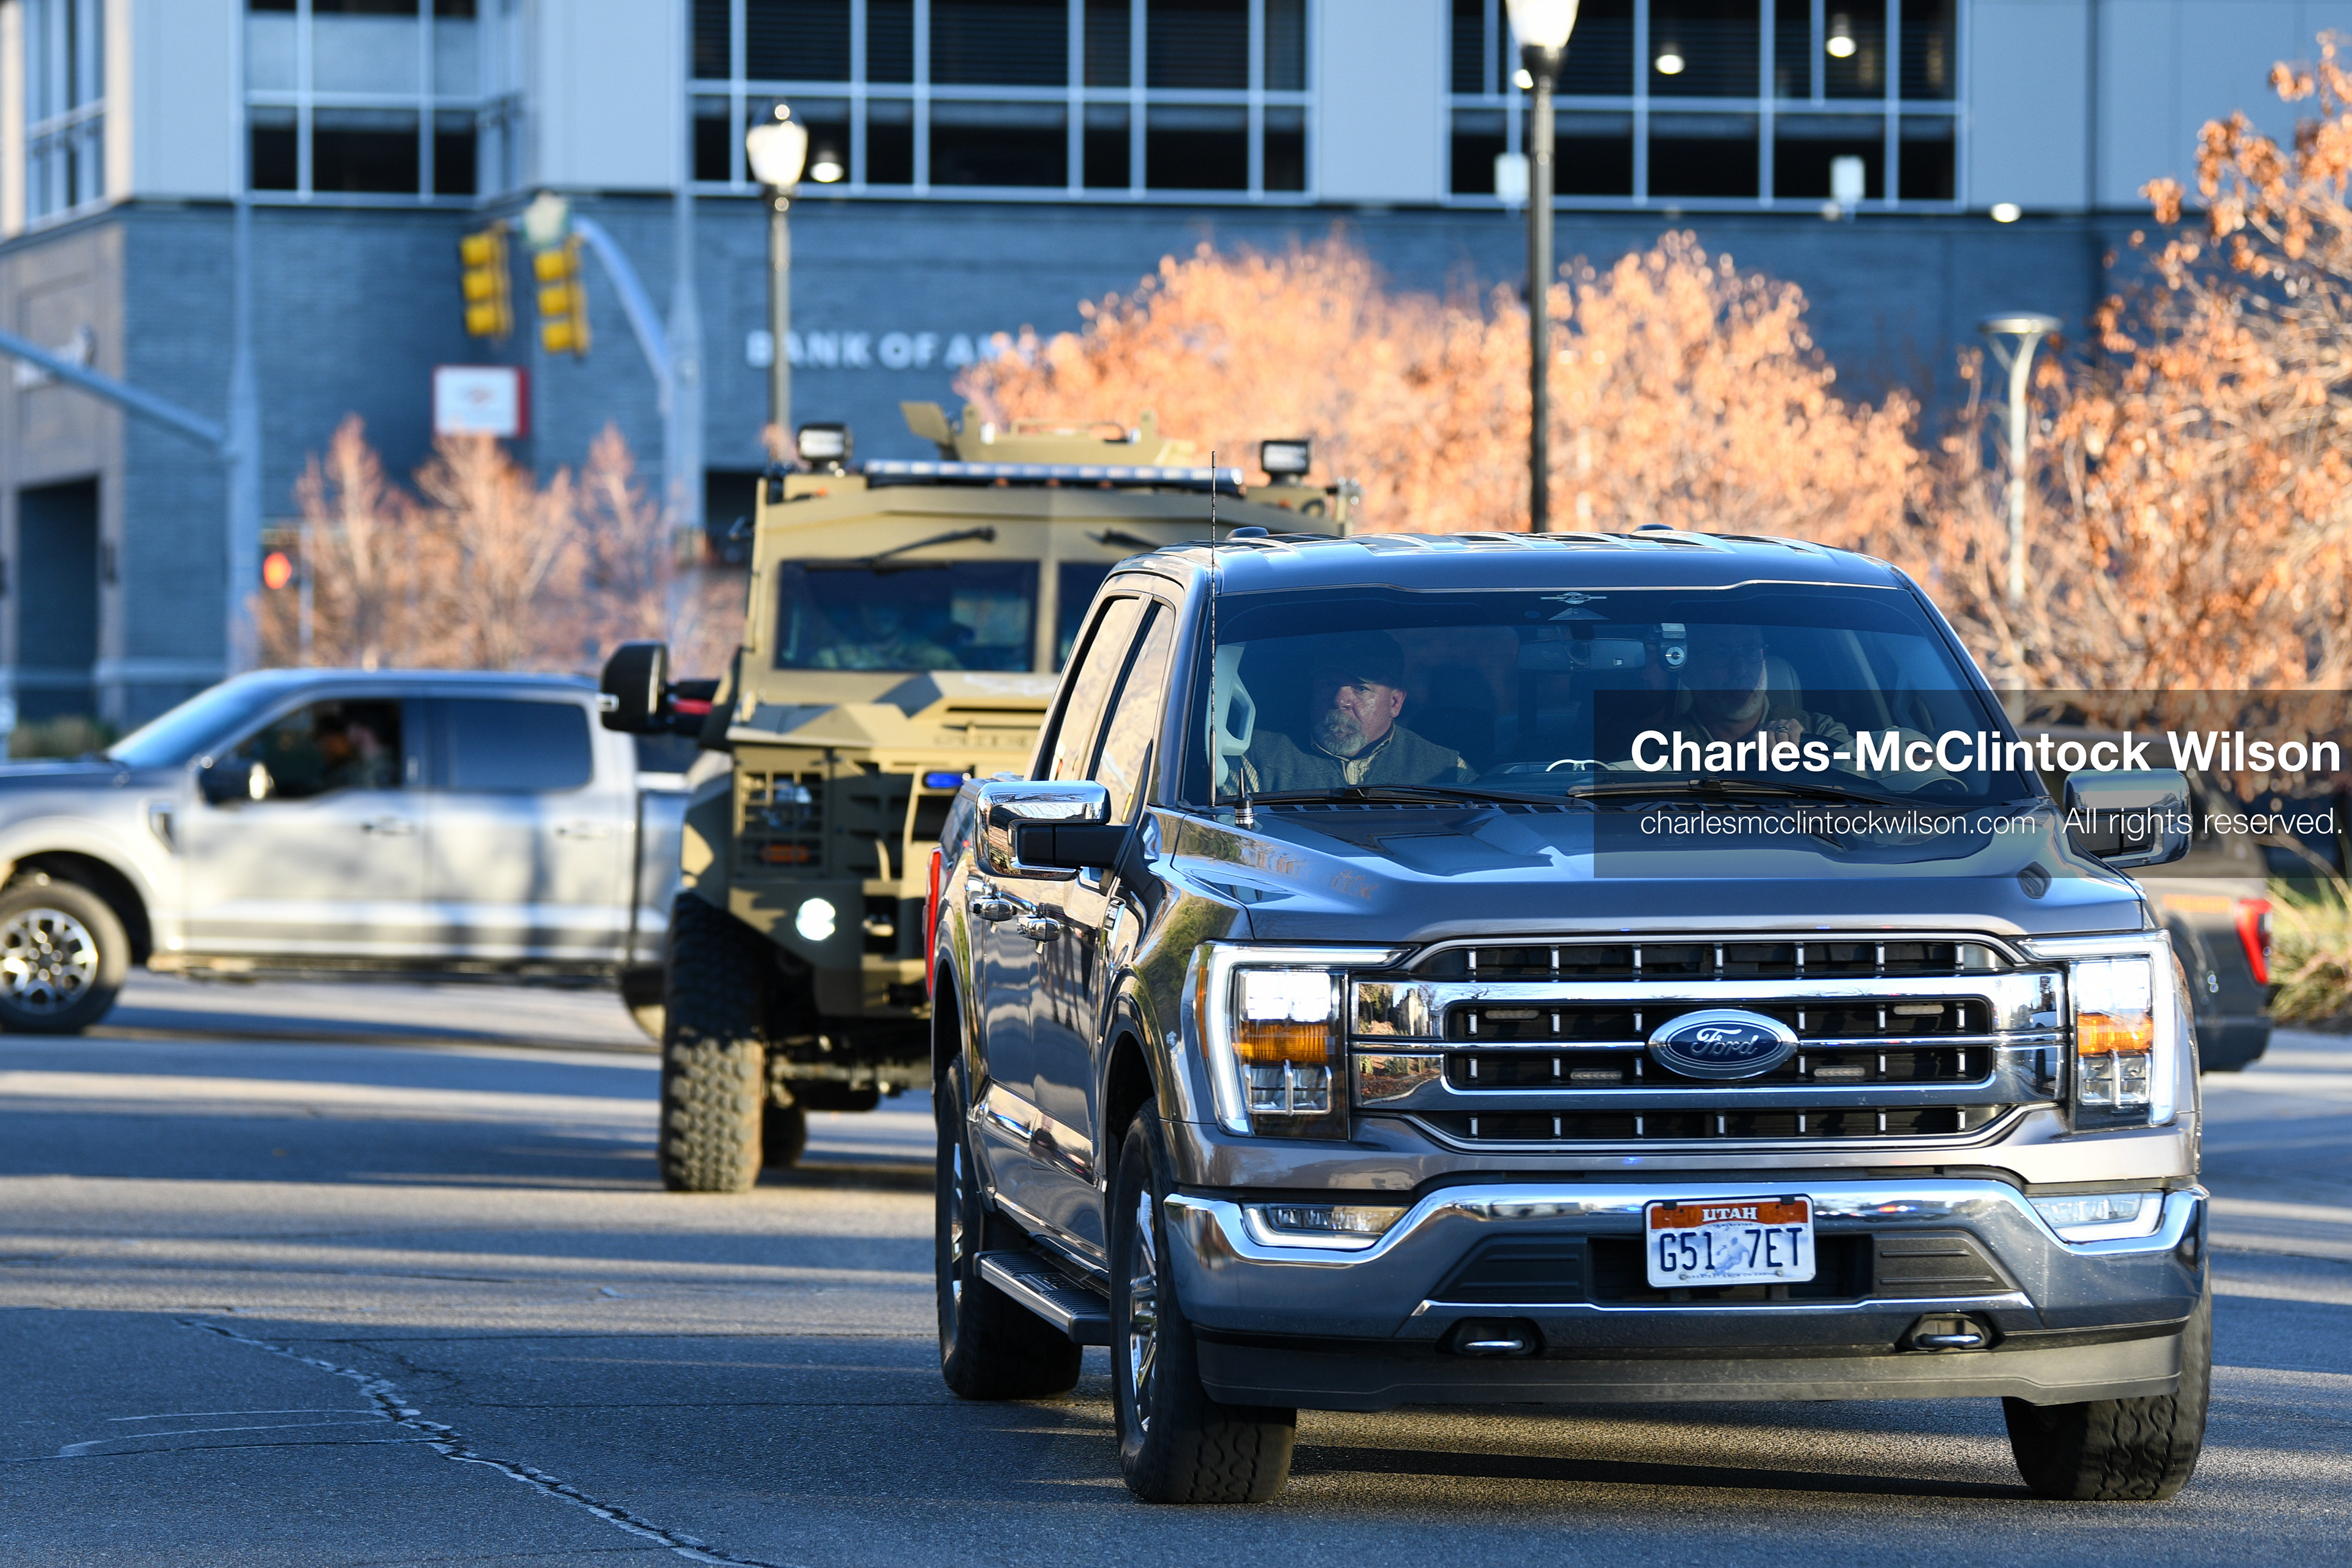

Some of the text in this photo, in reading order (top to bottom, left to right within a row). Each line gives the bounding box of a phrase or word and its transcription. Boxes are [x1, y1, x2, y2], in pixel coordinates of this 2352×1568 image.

[745, 330, 871, 368] BANK
[878, 331, 938, 369] OF
[1691, 1027, 1760, 1056] Ford
[1702, 1207, 1758, 1222] UTAH
[1660, 1227, 1803, 1272] G51 7ET
